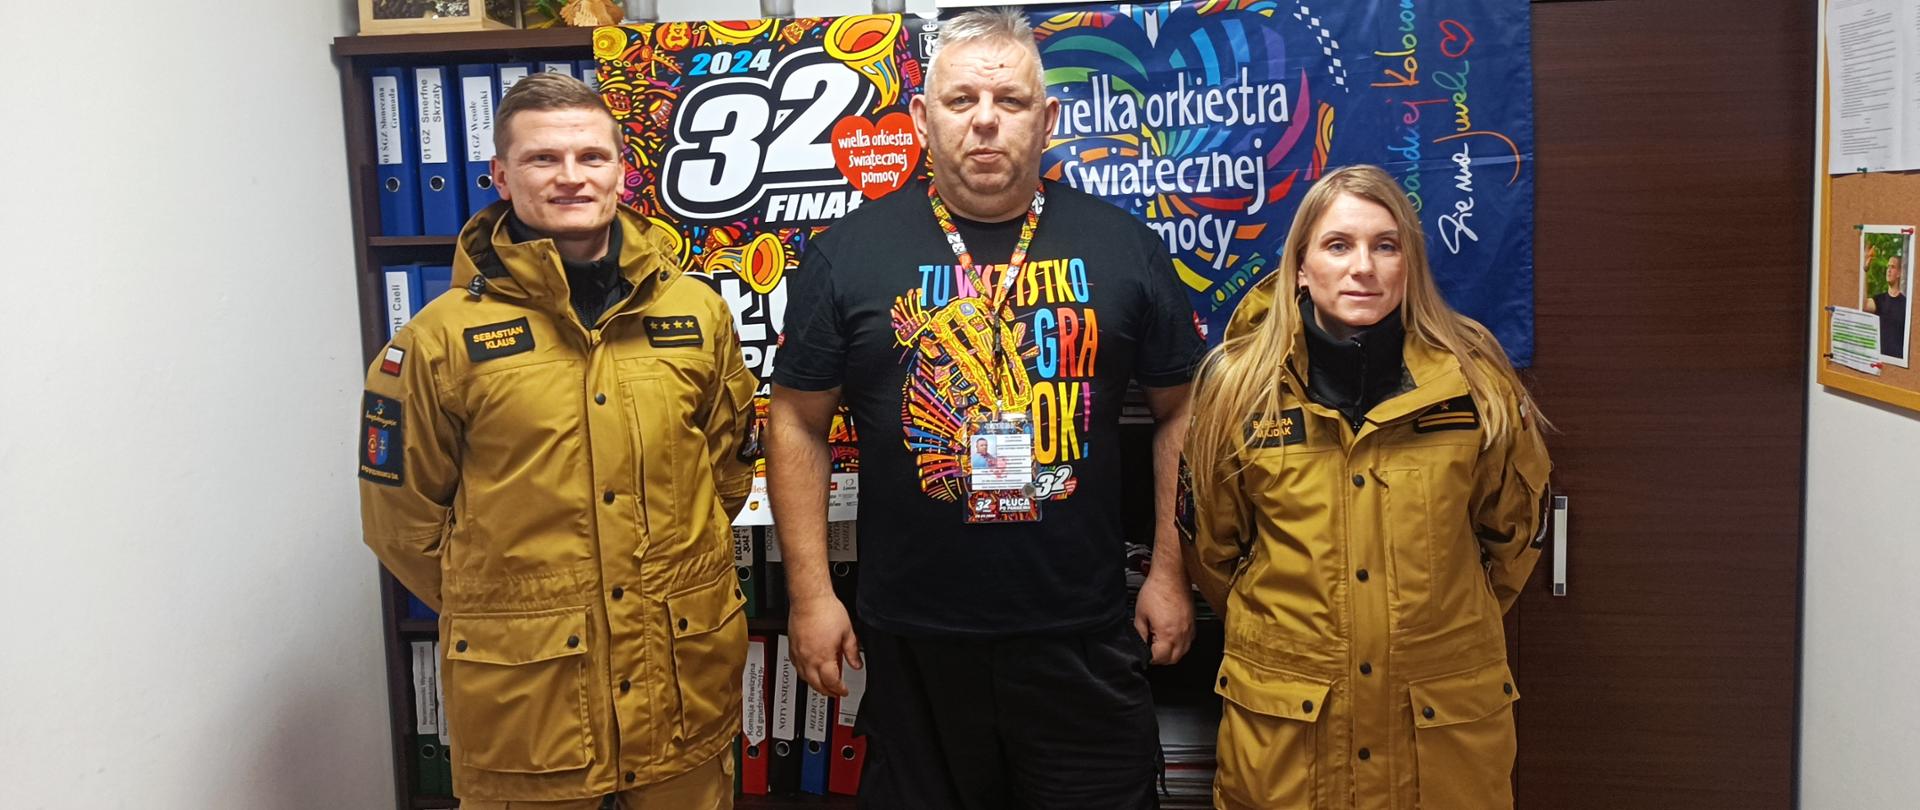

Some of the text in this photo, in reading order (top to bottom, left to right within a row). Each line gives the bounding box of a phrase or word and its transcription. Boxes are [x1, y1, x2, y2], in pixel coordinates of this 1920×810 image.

[688, 48, 772, 76] 2024
[388, 88, 398, 129] Gromada
[432, 83, 443, 123] Skrzaty
[480, 90, 491, 130] Muminki
[1146, 66, 1289, 128] orkiestra
[420, 79, 432, 160] 01 GZ Smerfne
[677, 62, 860, 203] 32
[471, 133, 481, 149] GZ
[472, 150, 481, 161] 02
[838, 128, 913, 150] wielka orkiestra
[848, 151, 908, 172] świątecznej
[1064, 137, 1266, 216] świątecznej
[861, 169, 900, 188] pomocy
[1147, 213, 1236, 271] mocy
[391, 284, 402, 312] Caeli
[918, 264, 951, 307] TU
[473, 326, 524, 343] SEBASTIAN
[485, 337, 516, 350] KLAUS
[1034, 307, 1099, 379] GRA
[1032, 381, 1091, 465] OK!
[1035, 467, 1071, 498] 32
[1000, 497, 1030, 507] PŁUCA
[778, 656, 790, 730] NOTY KSIĘGOWE
[746, 704, 756, 737] Komisja
[756, 725, 763, 737] Od
